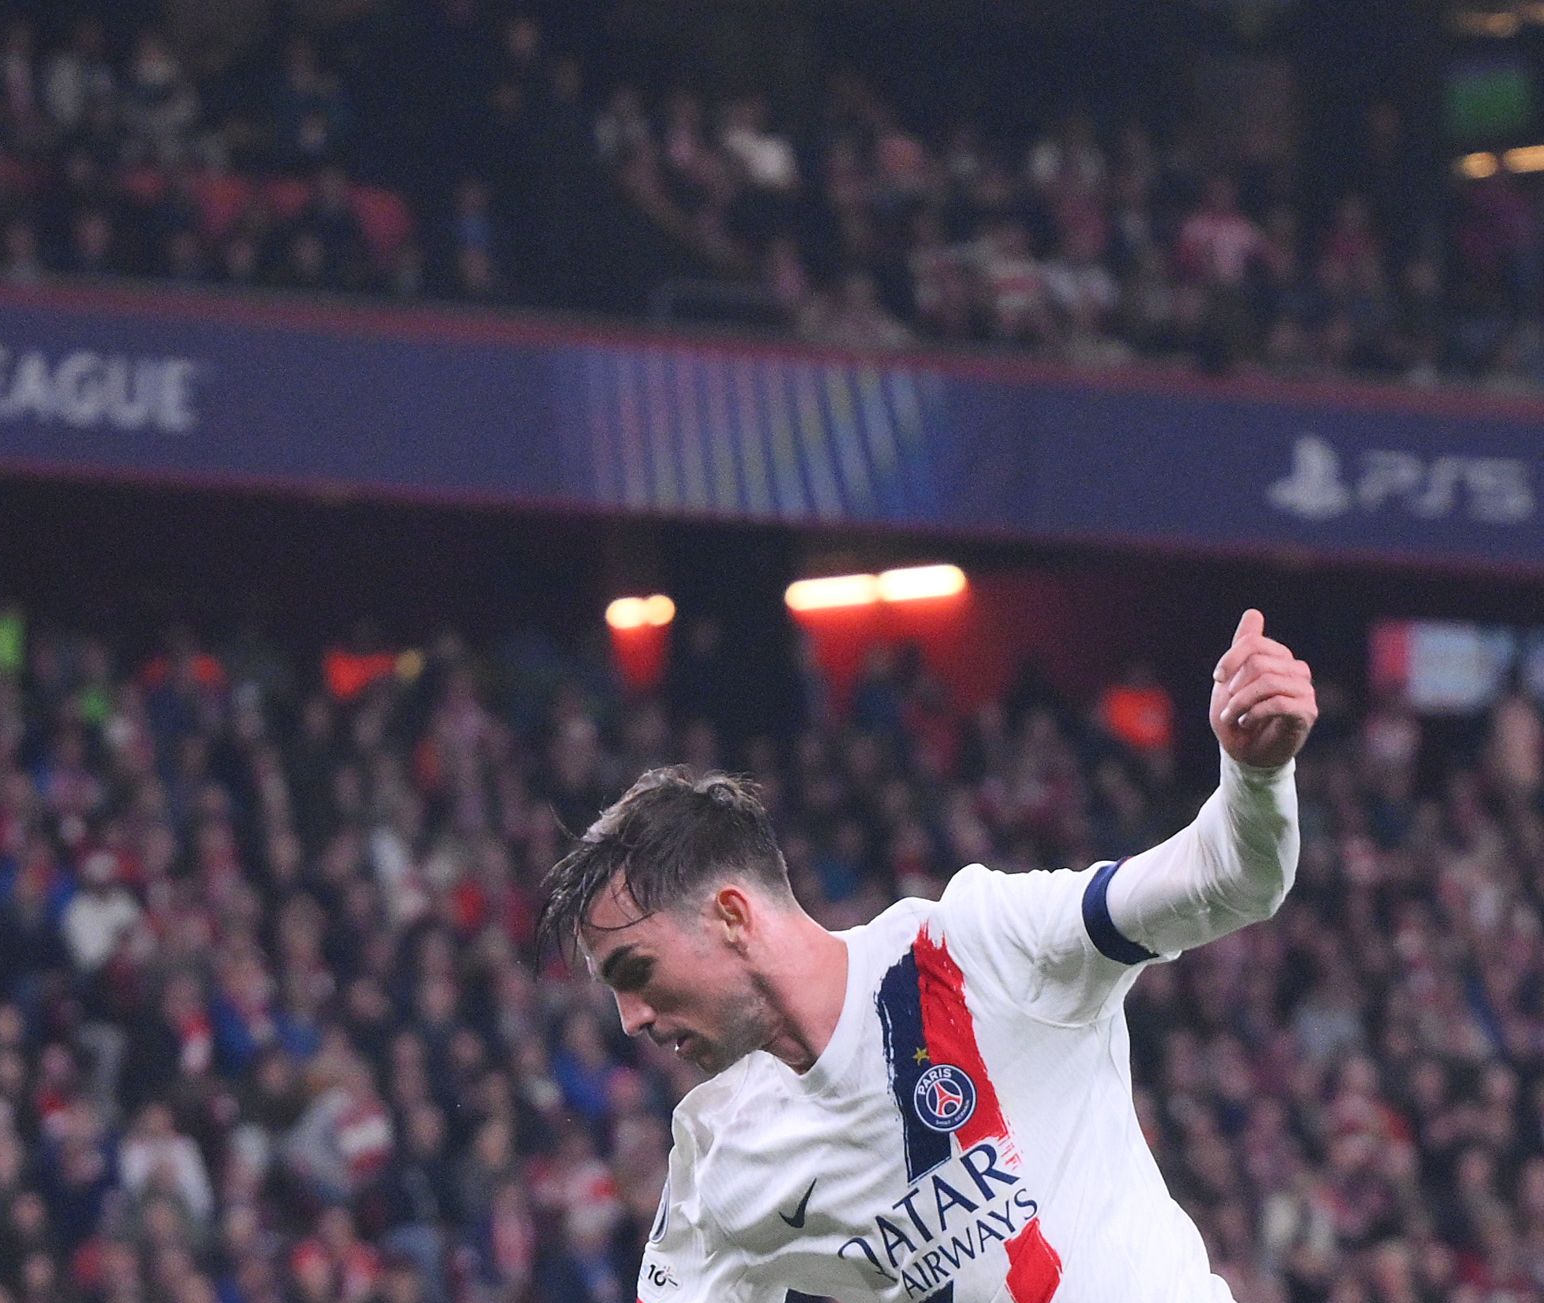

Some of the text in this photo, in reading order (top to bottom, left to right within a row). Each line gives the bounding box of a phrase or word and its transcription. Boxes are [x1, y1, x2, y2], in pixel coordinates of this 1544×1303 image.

[1358, 450, 1534, 524] PS5
[917, 1068, 952, 1095] PARIS
[900, 1187, 1038, 1300] AIRWAYS
